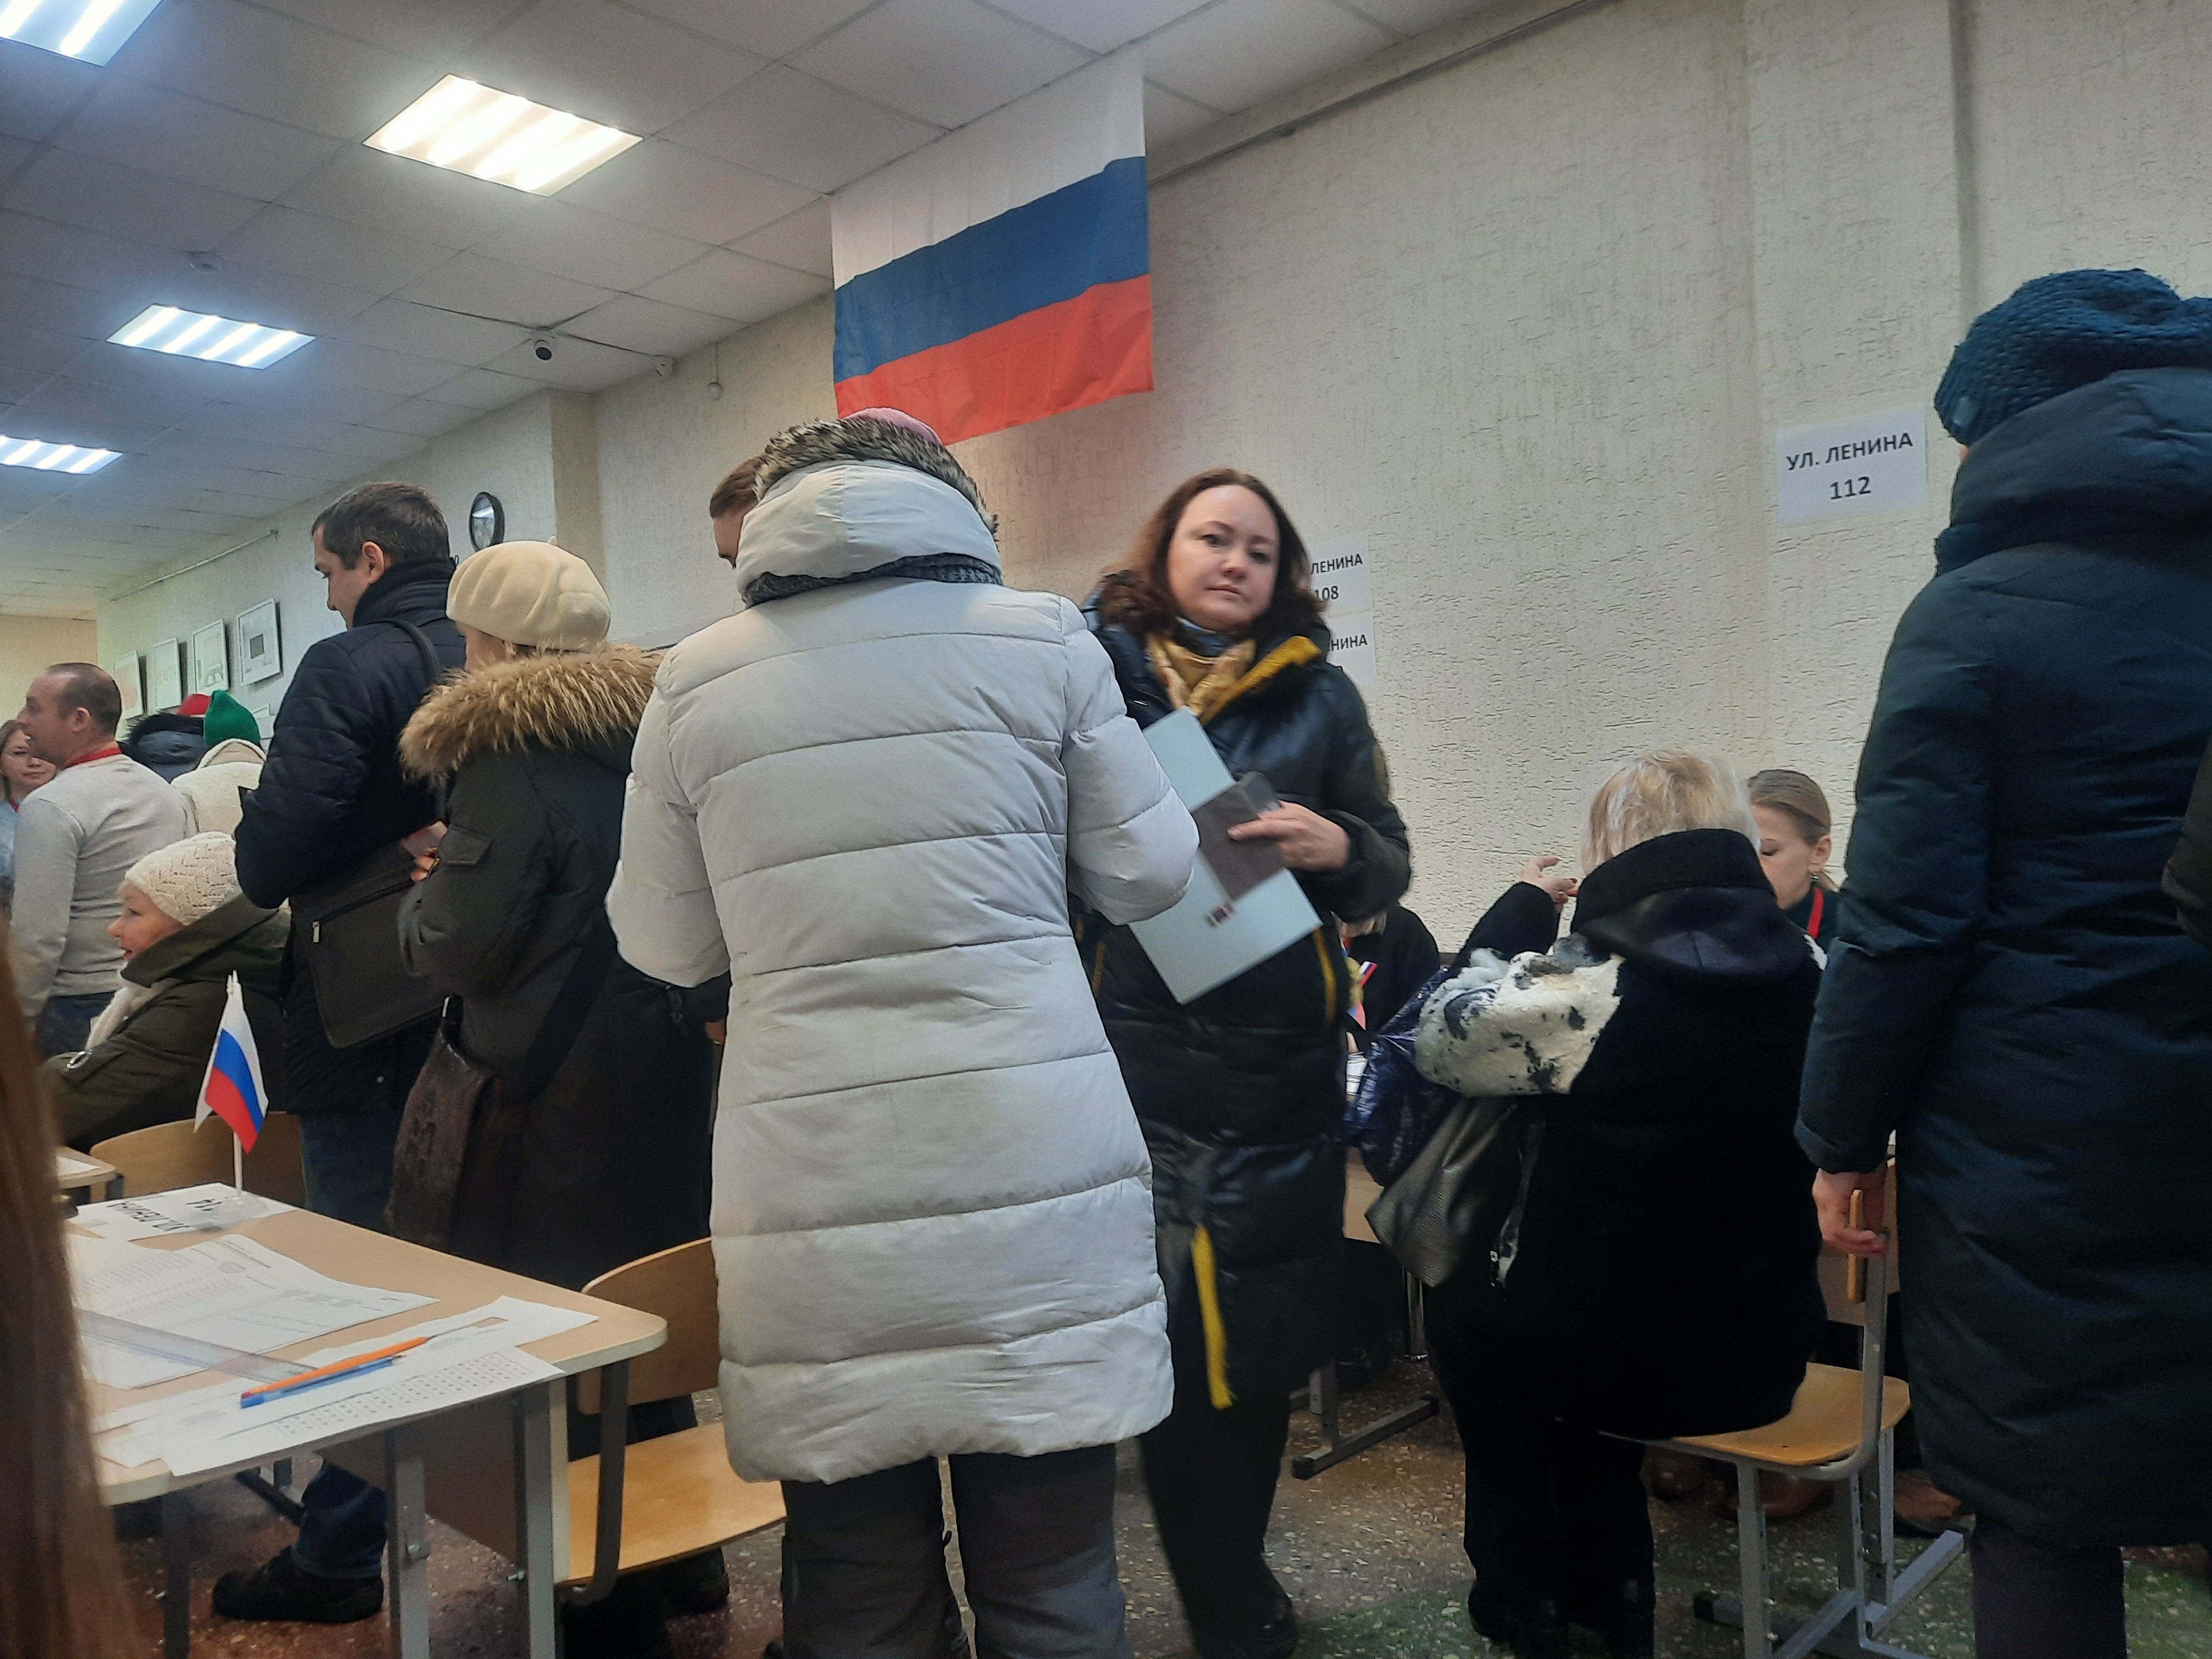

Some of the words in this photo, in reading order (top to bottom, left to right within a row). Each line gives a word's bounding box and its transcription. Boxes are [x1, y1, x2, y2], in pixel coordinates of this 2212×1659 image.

[1786, 452, 1819, 471] УЛ.
[1825, 432, 1914, 463] ЛЕНИНА
[1829, 476, 1872, 500] 112
[1311, 554, 1363, 575] ЛЕНИНА
[1331, 634, 1368, 651] НИНА
